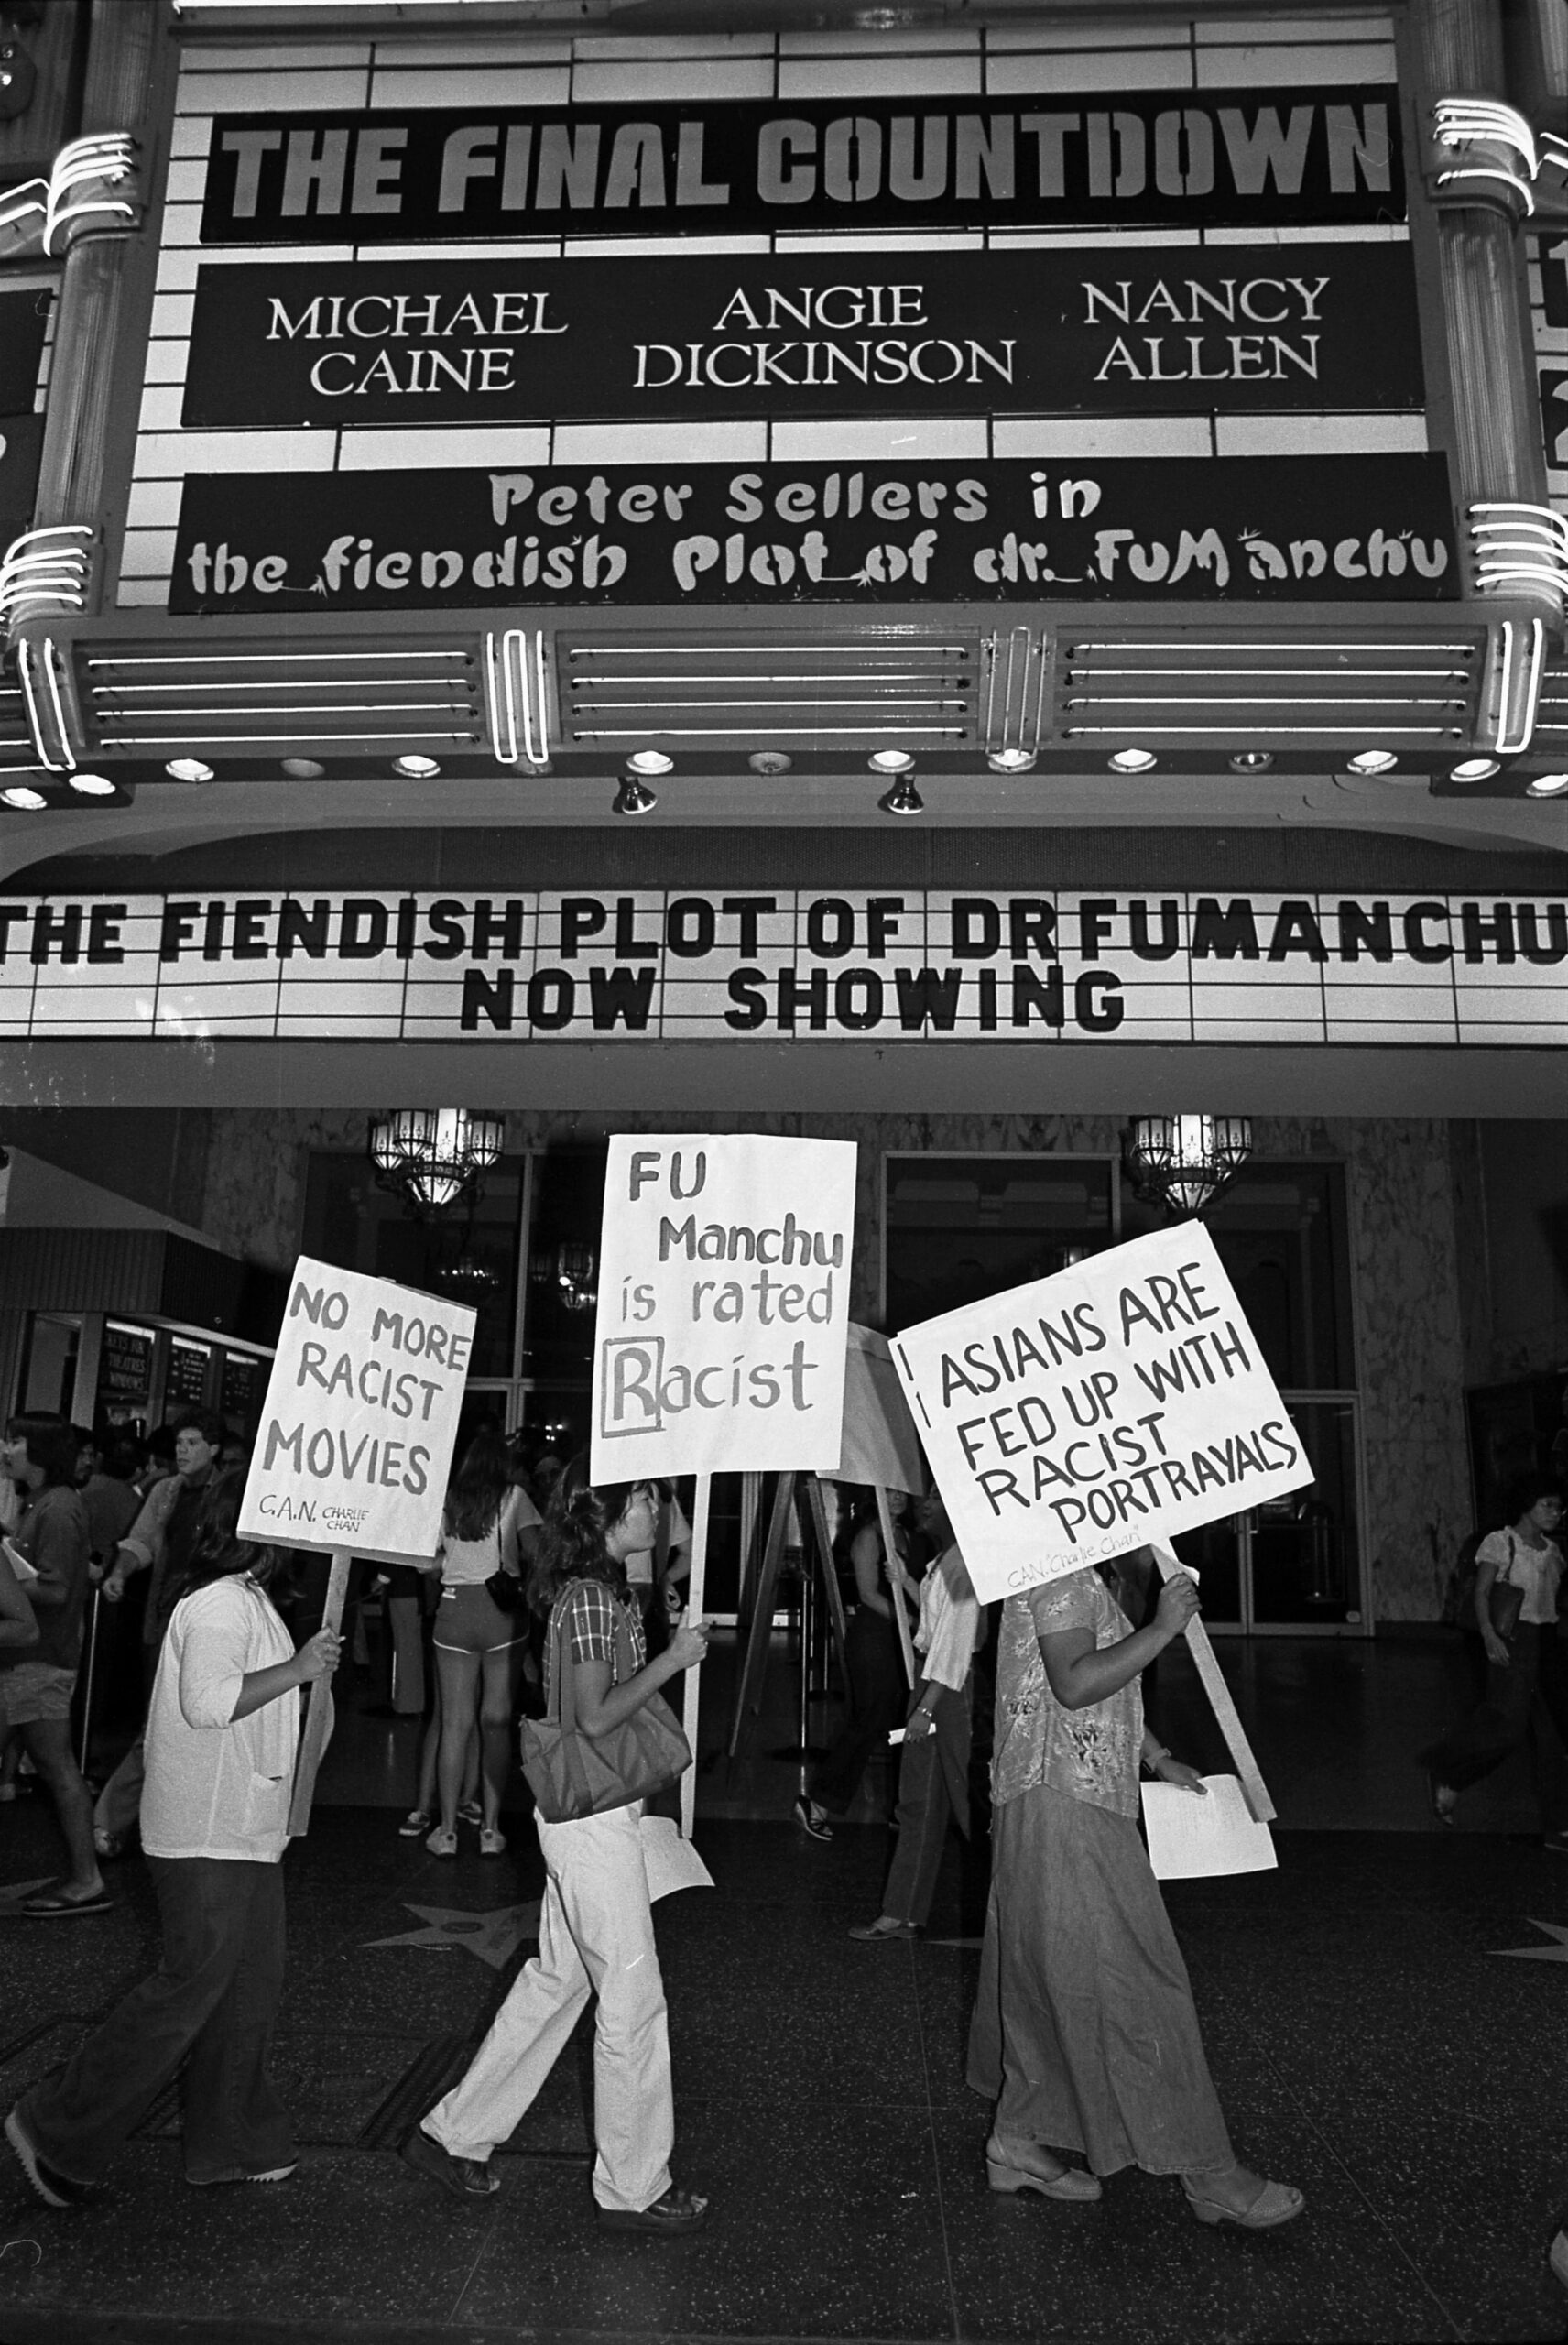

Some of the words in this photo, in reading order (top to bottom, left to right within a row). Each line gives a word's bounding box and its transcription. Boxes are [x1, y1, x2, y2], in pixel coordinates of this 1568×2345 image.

[221, 127, 408, 218] THE
[437, 121, 731, 213] FINAL
[757, 103, 1391, 204] COUNTDOWN
[266, 292, 569, 341] MICHAEL
[712, 284, 929, 331] ANGIE
[1080, 277, 1331, 324] NANCY
[310, 347, 516, 396] CAINE
[633, 339, 1017, 387] DICKINSON
[1093, 334, 1321, 381] ALLEN
[488, 473, 693, 527] Peter
[724, 471, 988, 523] Sellers
[1032, 471, 1102, 519] in
[186, 541, 289, 594] the
[321, 534, 628, 594] fiendish
[865, 529, 939, 584] of
[0, 904, 127, 965] THE
[159, 898, 525, 964] FIENDISH
[560, 896, 777, 960] PLOT
[806, 897, 905, 960] OF
[951, 897, 1058, 962] DR
[460, 967, 657, 1031] NOW
[723, 965, 1125, 1033] SHOWING
[629, 1151, 707, 1202] FU
[658, 1212, 844, 1269] Manchu
[290, 1282, 349, 1331] NO
[371, 1308, 472, 1372] MORE
[622, 1275, 657, 1323] is
[691, 1269, 833, 1325] rated
[942, 1303, 1107, 1408] ASIANS
[1118, 1261, 1221, 1347] ARE
[297, 1341, 444, 1421] RACIST
[612, 1340, 820, 1422] Racist
[956, 1396, 1057, 1471] FED
[1062, 1371, 1119, 1427] UP
[1133, 1321, 1253, 1403] WITH
[262, 1418, 431, 1496] MOVIES
[975, 1412, 1166, 1517] RACIST
[1049, 1421, 1298, 1544] PORTRAYALS
[326, 1520, 361, 1532] CHAN
